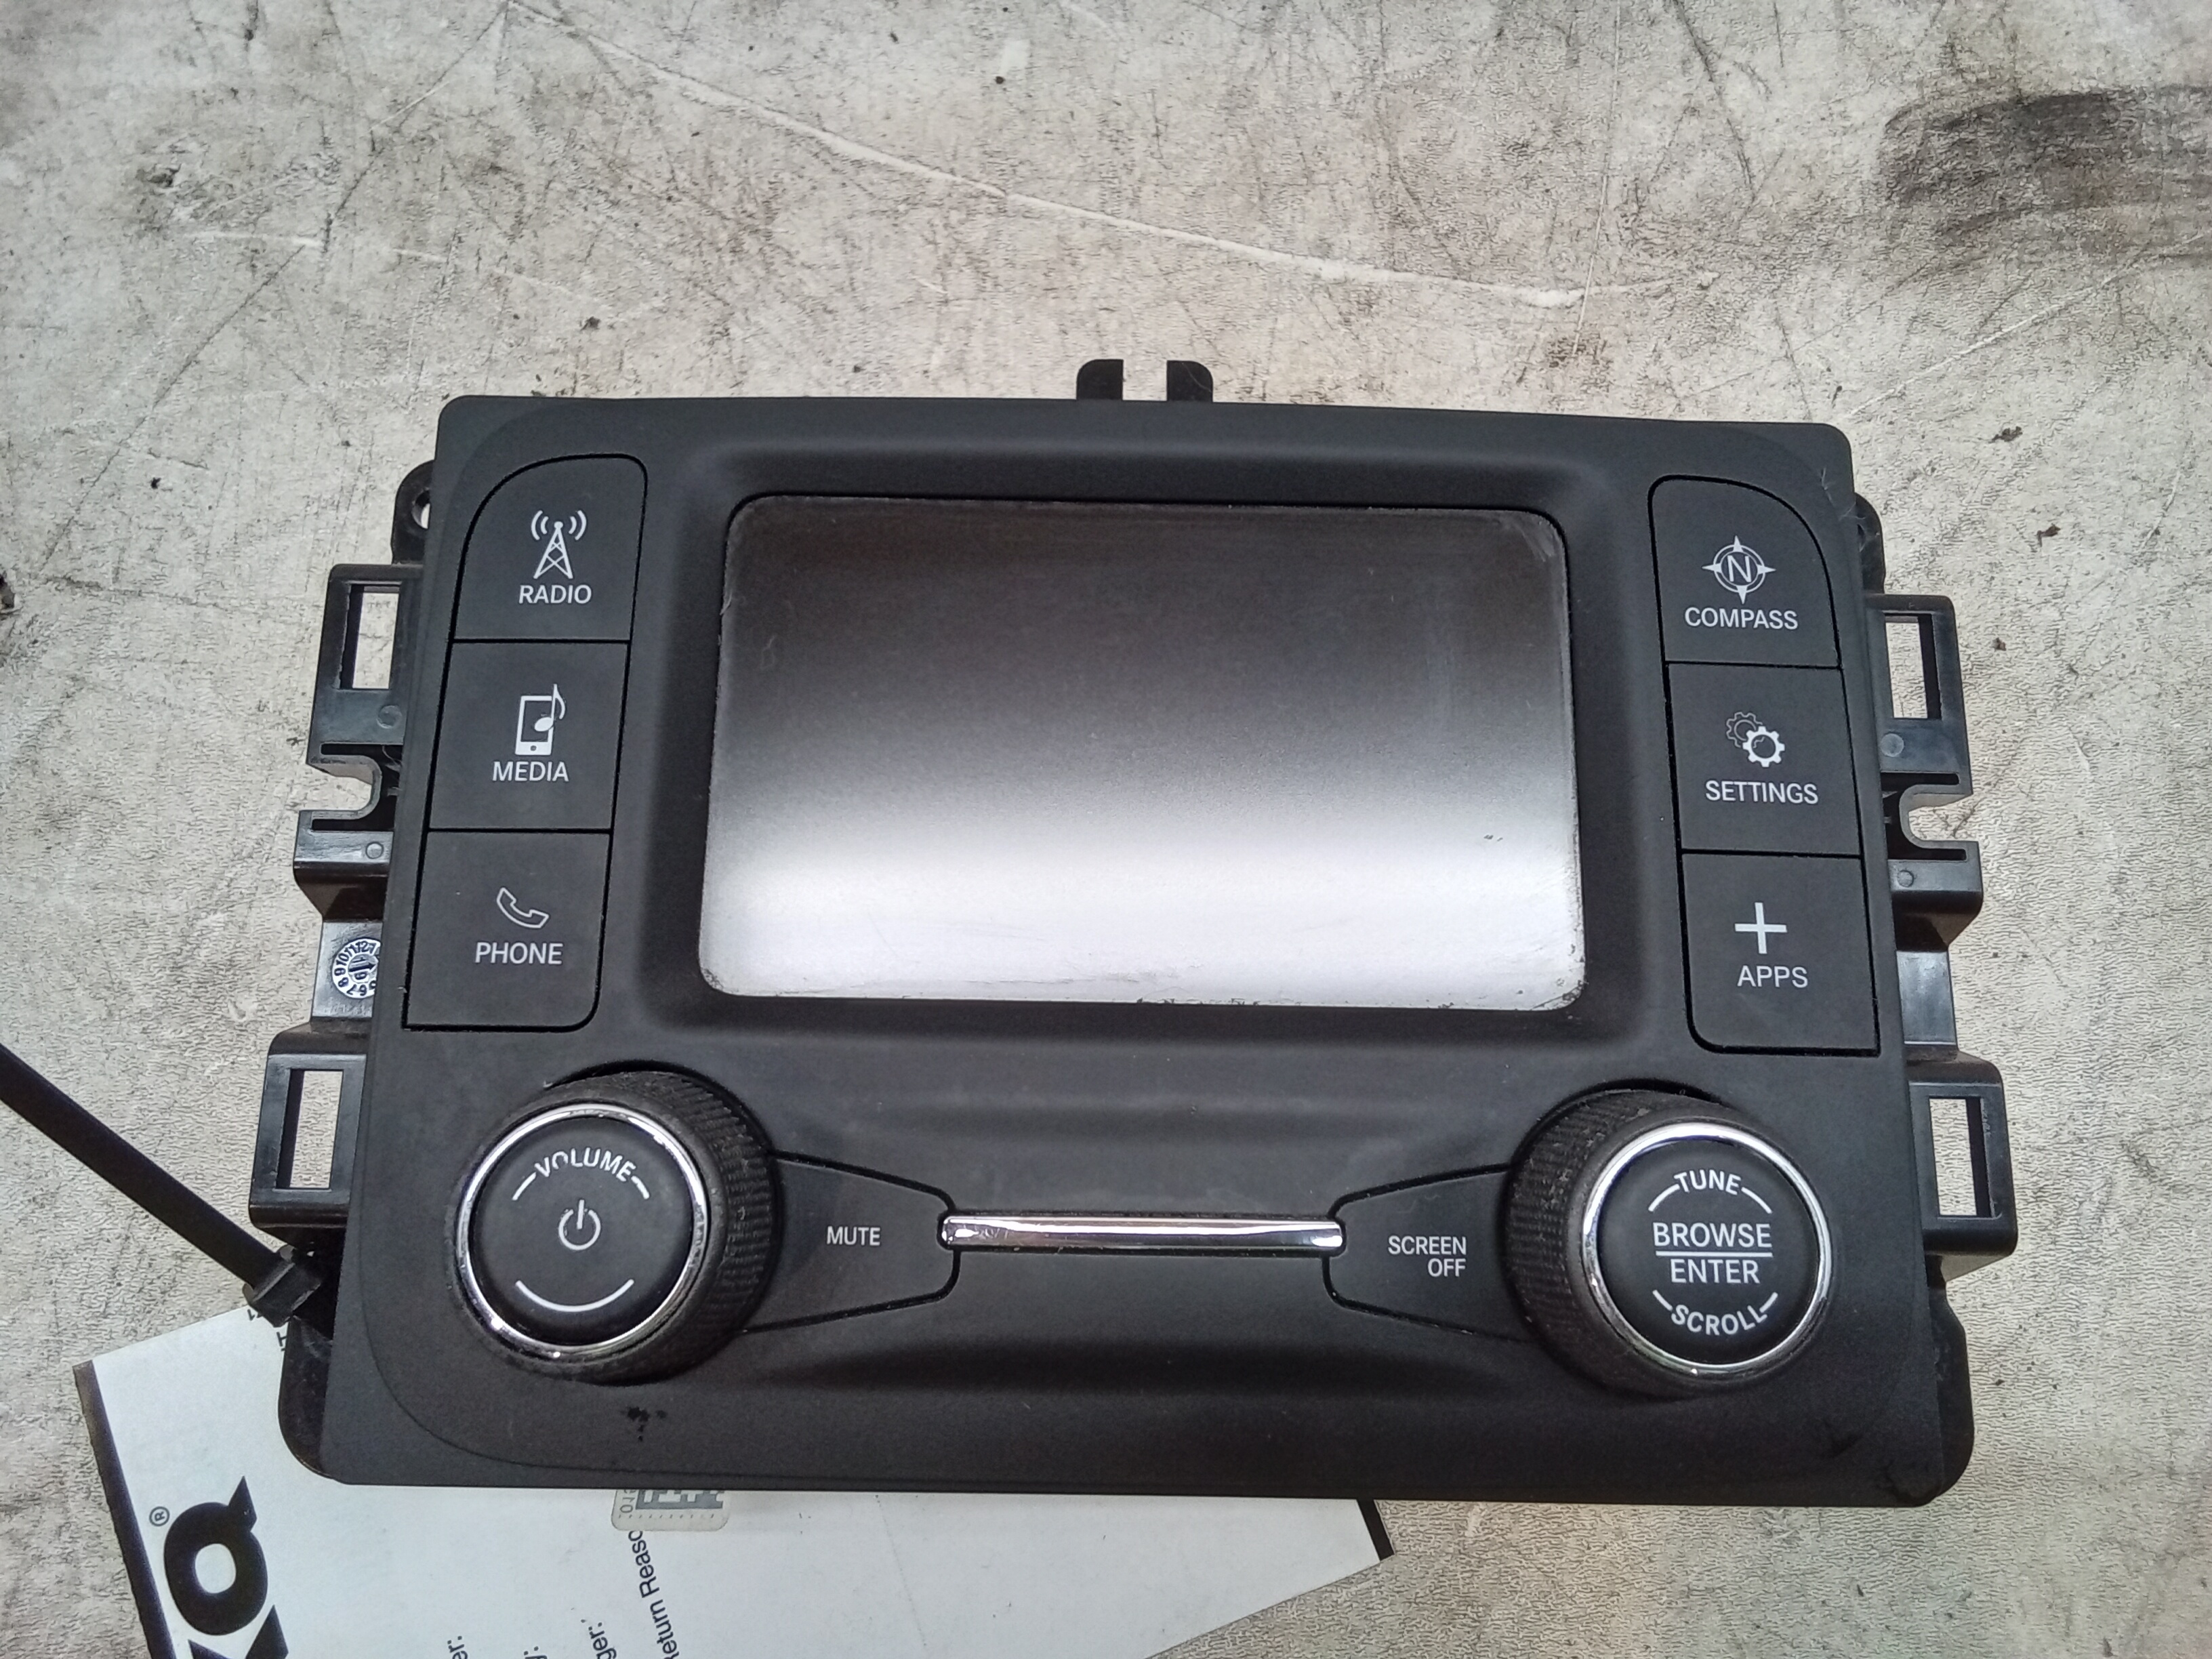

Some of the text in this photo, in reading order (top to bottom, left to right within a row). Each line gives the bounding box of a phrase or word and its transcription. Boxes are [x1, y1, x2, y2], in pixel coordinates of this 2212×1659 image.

[1727, 554, 1752, 583] N
[518, 584, 592, 605] RADIO
[1684, 607, 1799, 630] COMPASS
[492, 760, 570, 782] MEDIA
[1705, 779, 1819, 804] SETTINGS
[475, 941, 564, 964] PHONE
[1737, 964, 1809, 989] APPS
[534, 1147, 636, 1183] VOLUME
[1673, 1169, 1742, 1195] TUNE
[826, 1225, 881, 1246] MUTE
[1387, 1235, 1467, 1255] SCREEN
[1652, 1222, 1773, 1248] BROWSE
[1427, 1258, 1467, 1277] OFF
[1670, 1258, 1761, 1284] ENTER
[1671, 1304, 1768, 1336] SCROLL
